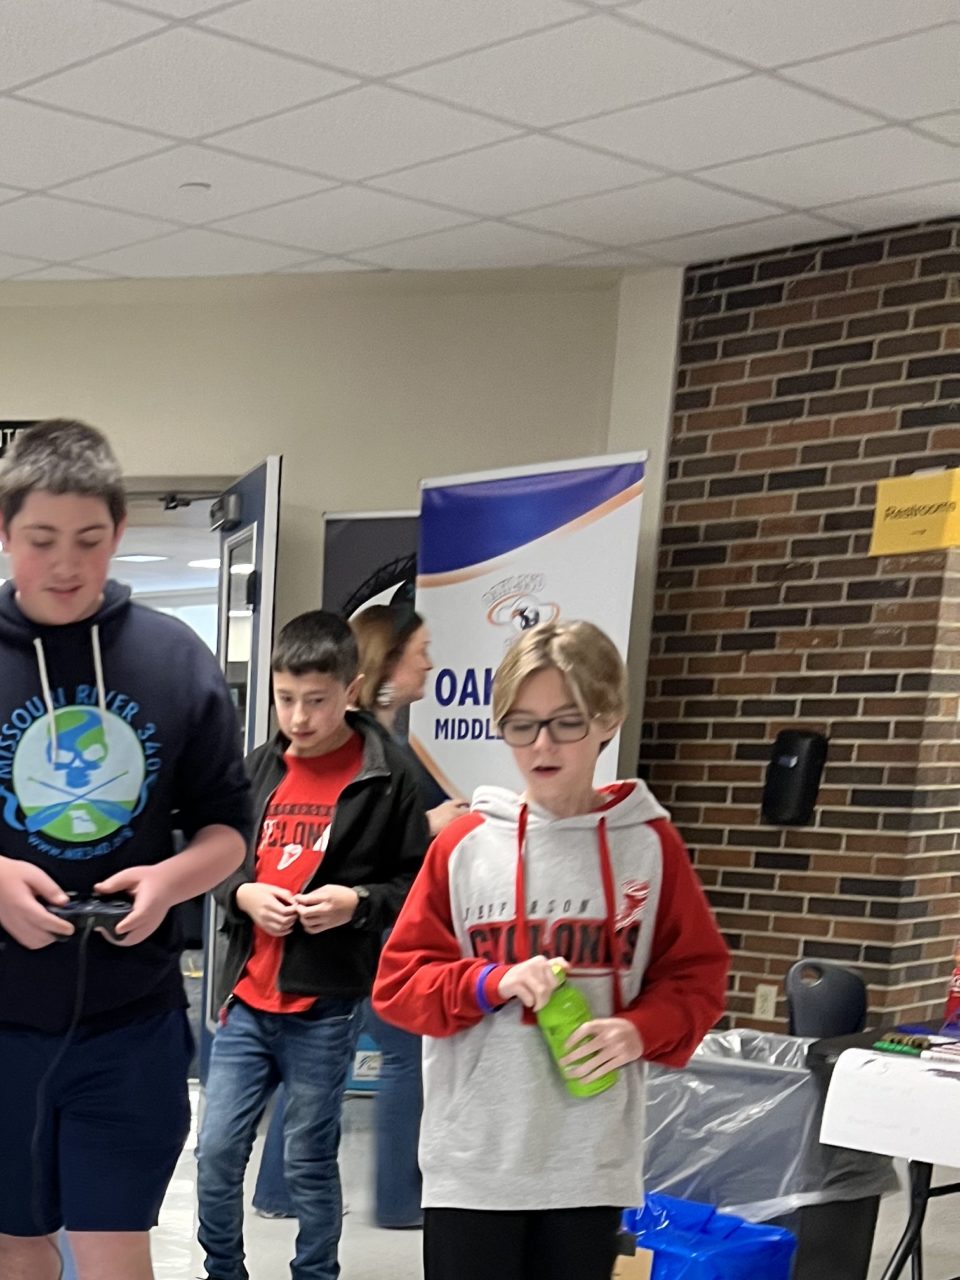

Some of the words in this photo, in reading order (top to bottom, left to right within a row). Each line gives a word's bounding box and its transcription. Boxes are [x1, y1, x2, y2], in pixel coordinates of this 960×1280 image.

[434, 667, 496, 707] OAK
[434, 718, 505, 740] MIDDL
[140, 722, 163, 771] 340
[463, 899, 592, 922] JEFFRSON
